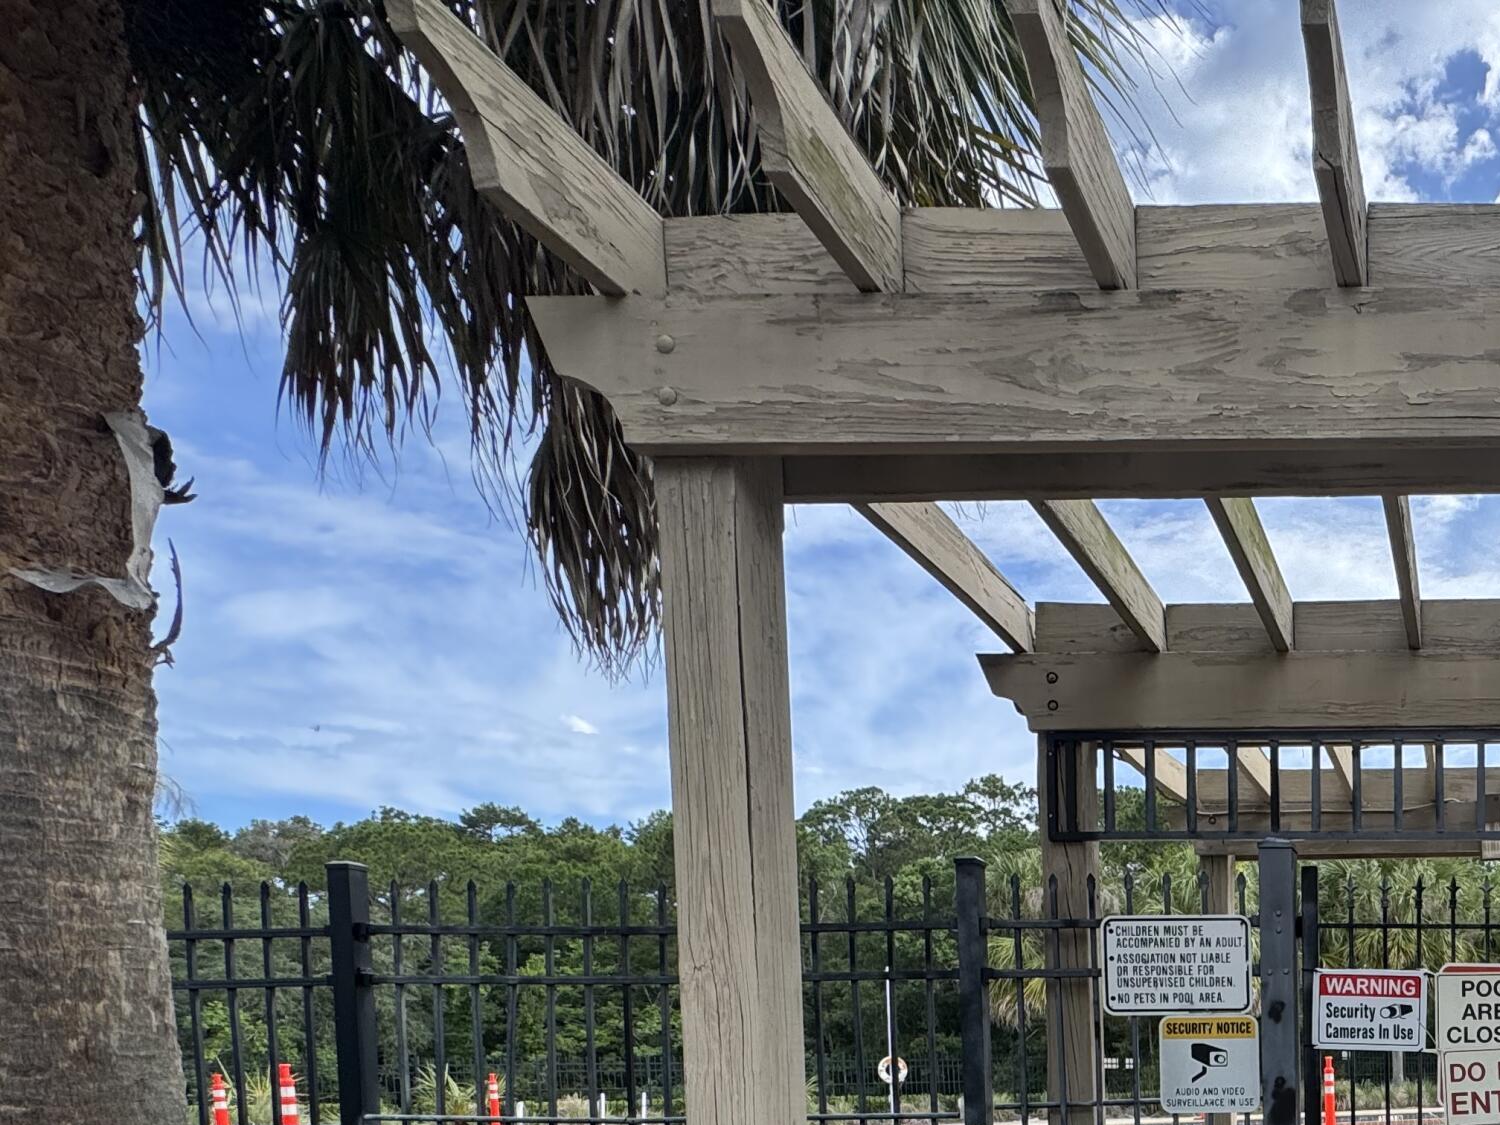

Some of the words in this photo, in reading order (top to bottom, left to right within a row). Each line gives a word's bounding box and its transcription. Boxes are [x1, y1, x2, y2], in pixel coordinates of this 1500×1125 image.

[1115, 926, 1160, 936] CHILDREN
[1164, 926, 1190, 936] MUST
[1193, 925, 1203, 936] BE
[1116, 937, 1180, 948] ACCOMPANIED
[1184, 937, 1195, 948] BY
[1200, 937, 1212, 948] AN
[1117, 953, 1175, 964] ASSOCIATION
[1180, 953, 1197, 963] NOT
[1201, 953, 1231, 963] LIABLE
[1117, 966, 1128, 976] OR
[1133, 966, 1193, 976] RESPONSIBLE
[1198, 965, 1214, 975] FOR
[1117, 977, 1185, 988] UNSUPERVISED
[1189, 977, 1235, 987] CHILDREN.
[1326, 977, 1416, 996] WARNING
[1118, 994, 1130, 1004] NO
[1134, 993, 1155, 1004] PETS
[1160, 993, 1168, 1003] IN
[1173, 993, 1194, 1004] POOL
[1199, 993, 1225, 1003] AREA.
[1326, 1003, 1375, 1022] Security
[1166, 1022, 1213, 1035] SECURITY
[1217, 1022, 1251, 1034] NOTICE
[1326, 1023, 1374, 1039] Cameras
[1379, 1024, 1389, 1039] In
[1394, 1024, 1413, 1040] Use
[1450, 1062, 1486, 1082] DO
[1176, 1088, 1199, 1096] AUDIO
[1222, 1087, 1245, 1095] VIDEO
[1166, 1099, 1224, 1107] SURVEILLANCE
[1239, 1098, 1254, 1106] USE
